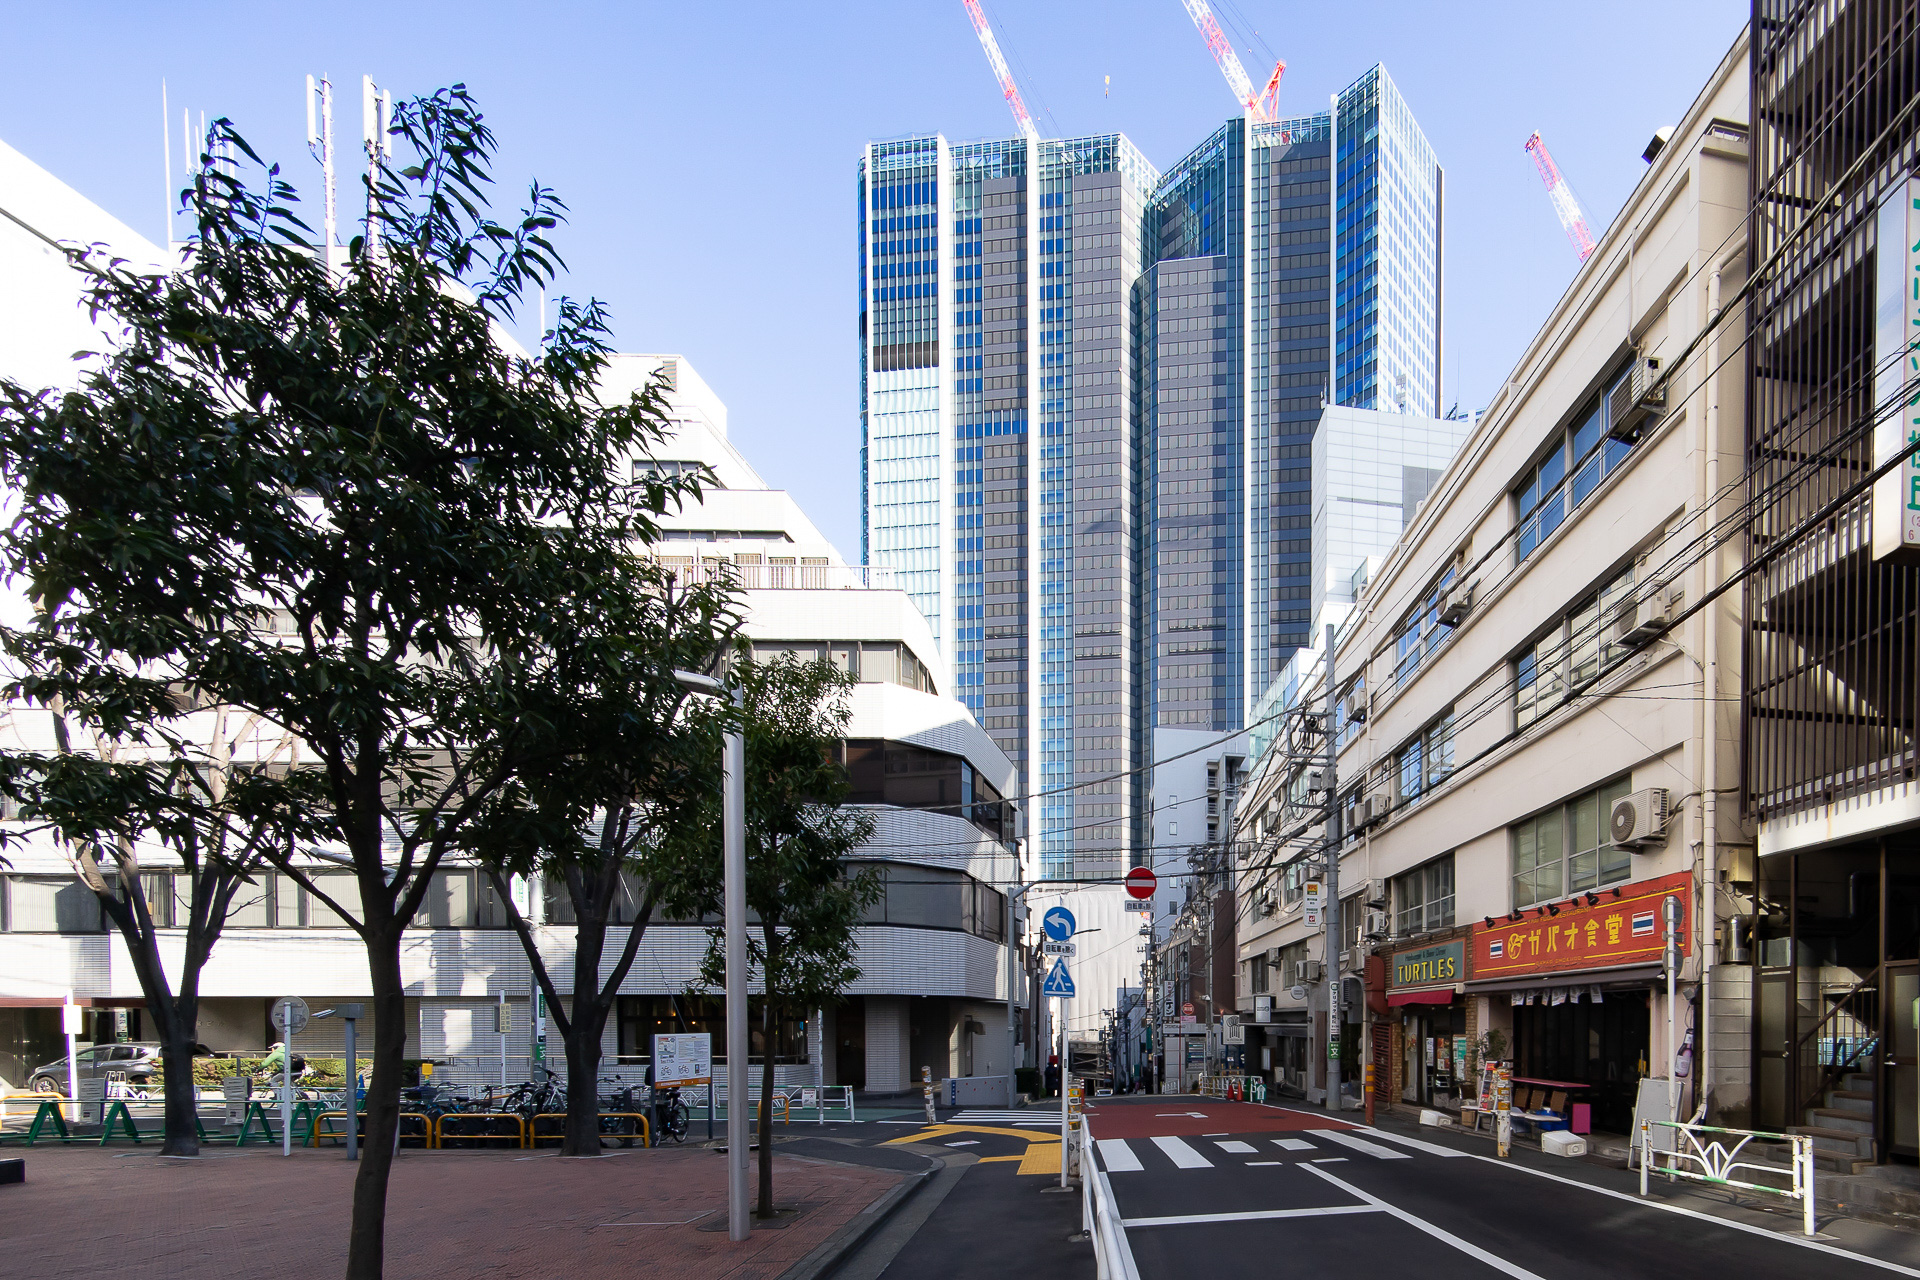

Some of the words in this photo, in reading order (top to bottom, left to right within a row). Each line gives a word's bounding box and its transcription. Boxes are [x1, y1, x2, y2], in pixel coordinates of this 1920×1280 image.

[1528, 913, 1623, 956] ガパオ食堂
[1046, 944, 1074, 954] 自転車を除く
[1398, 957, 1455, 983] TURTLES
